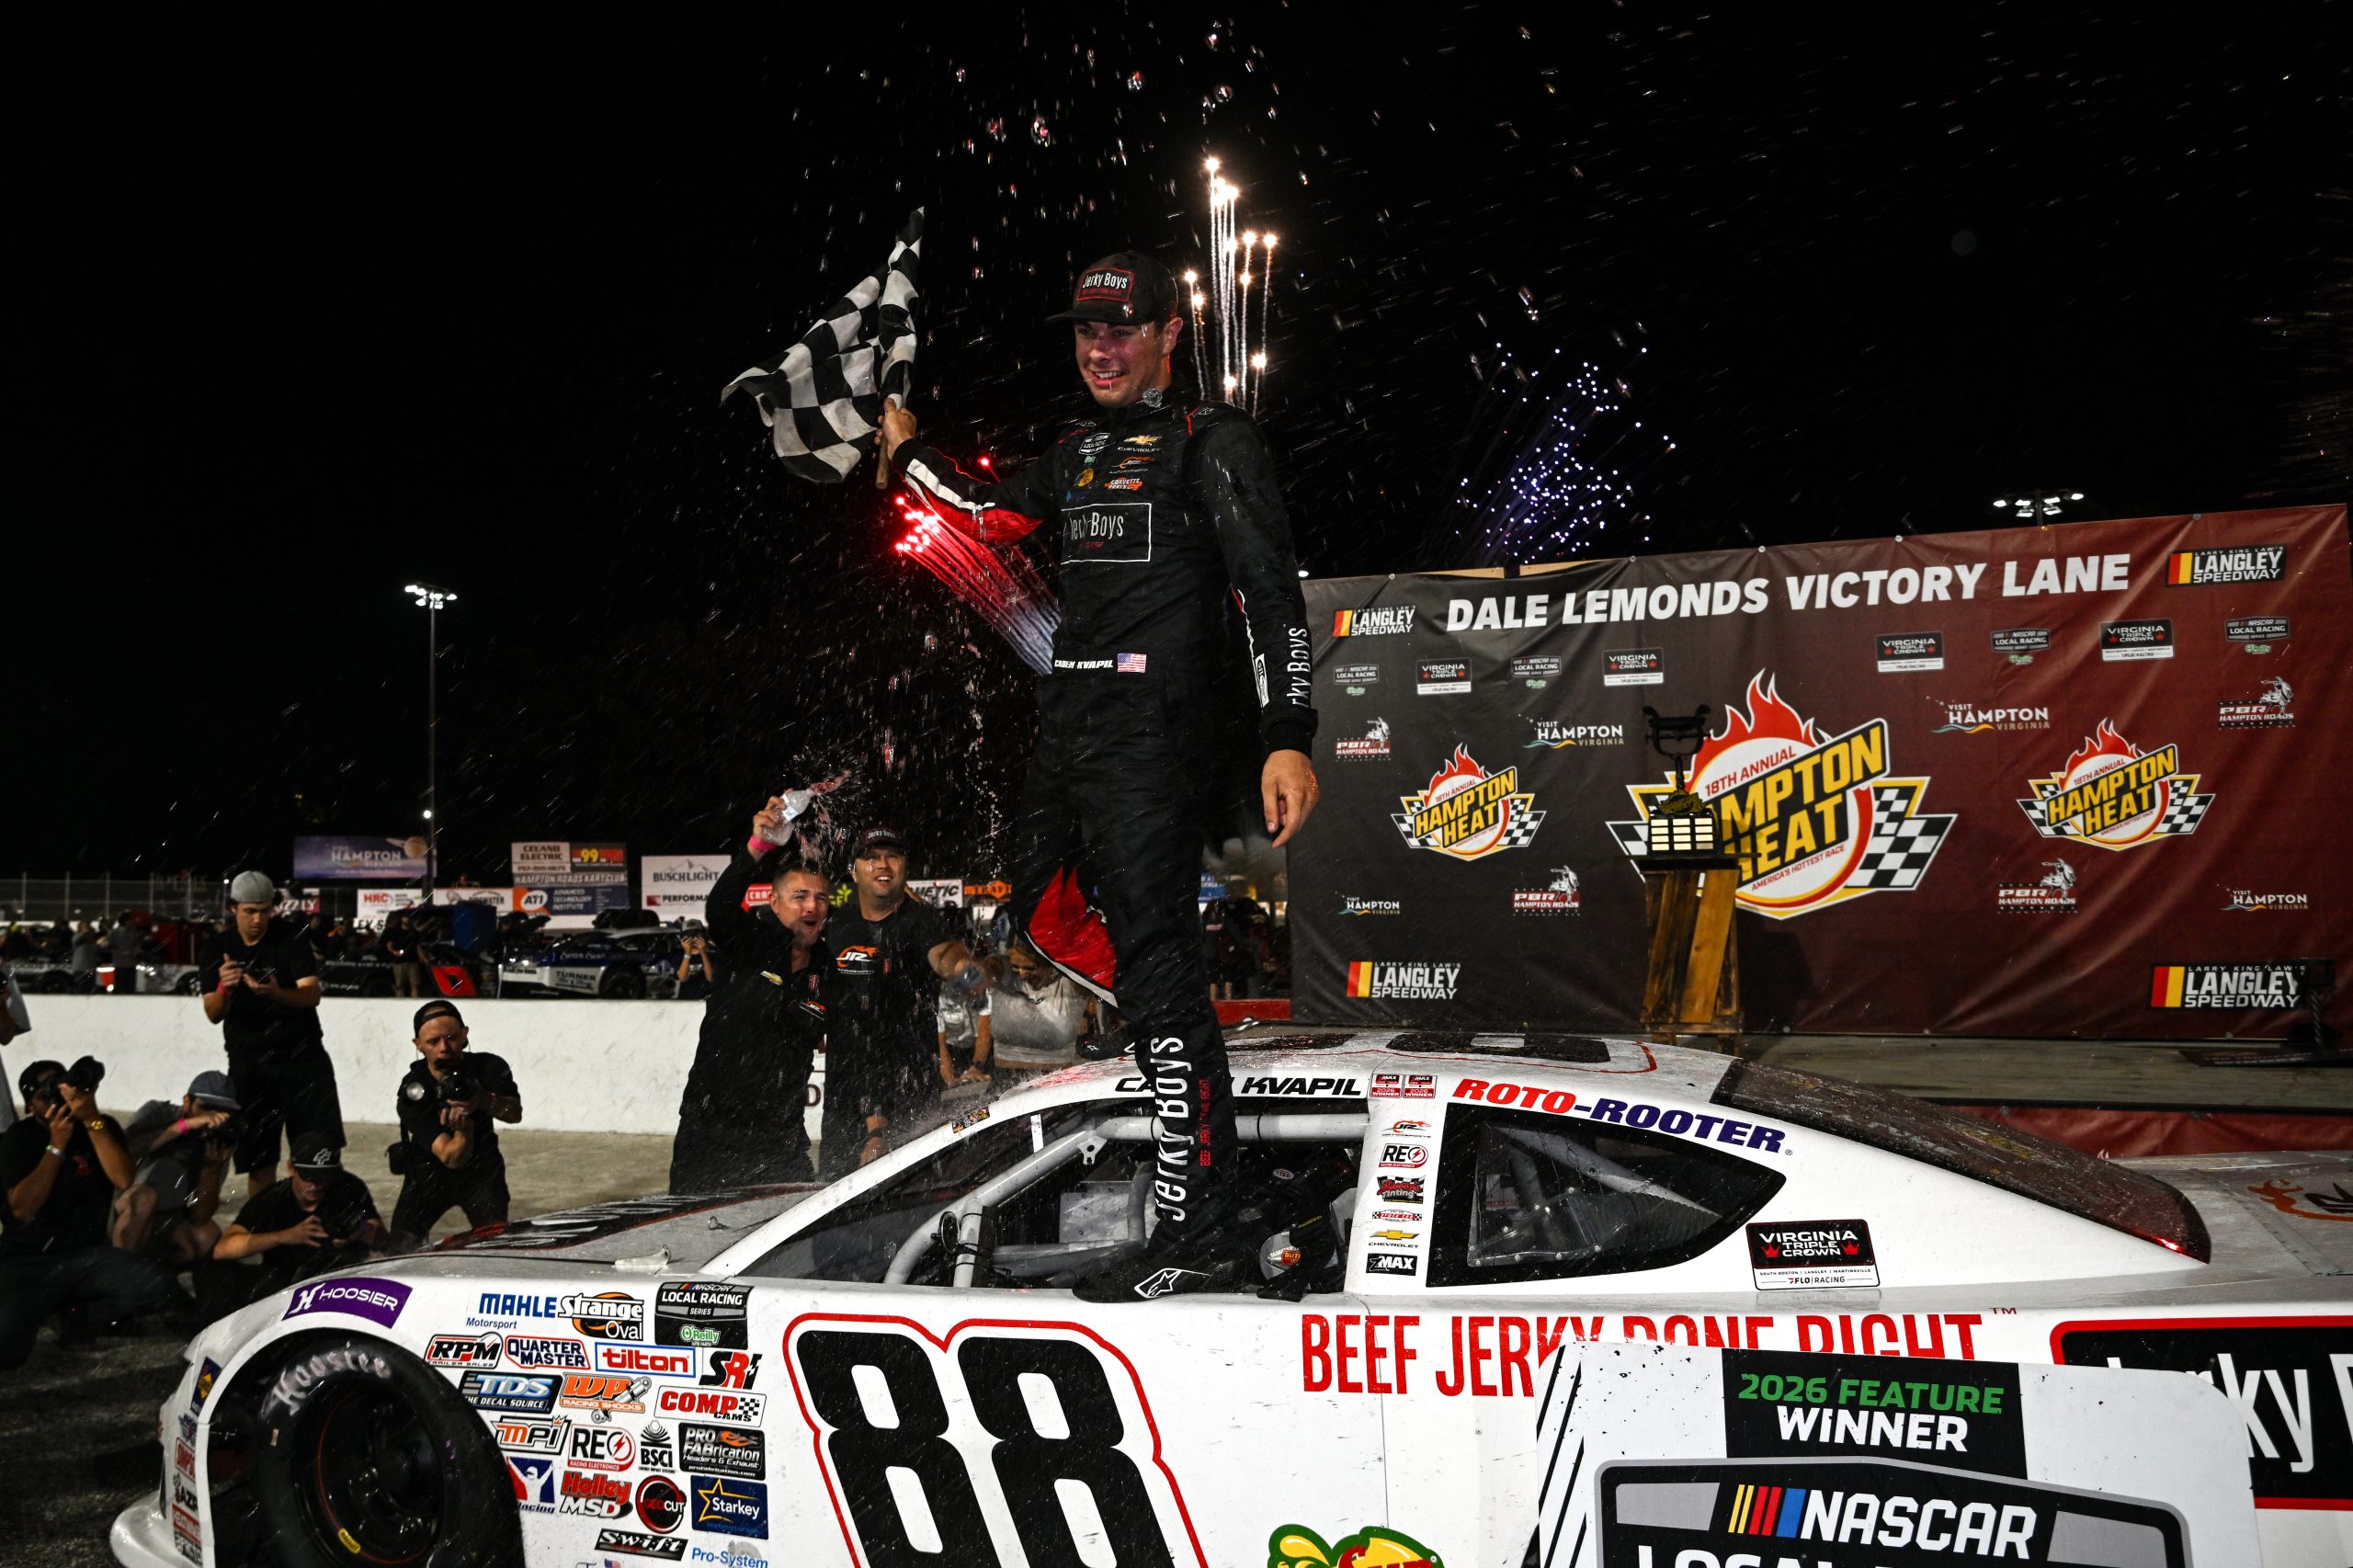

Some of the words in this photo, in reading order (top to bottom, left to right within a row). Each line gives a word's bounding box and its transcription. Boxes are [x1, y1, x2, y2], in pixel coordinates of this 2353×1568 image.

[1082, 273, 1103, 288] Jerky
[1104, 272, 1128, 289] Boys
[1090, 512, 1124, 540] Boys
[2194, 551, 2283, 574] LANGLEY
[2193, 568, 2280, 584] SPEEDWAY
[1447, 595, 1549, 631] DALE
[1563, 579, 1768, 625] LEMONDS
[1786, 562, 1987, 610] VICTORY
[2002, 553, 2131, 597] LANE
[1351, 609, 1416, 628] LANGLEY
[1351, 624, 1414, 636] SPEEDWAY
[2107, 625, 2165, 634] VIRGINIA
[1287, 628, 1312, 673] Boys
[1882, 638, 1937, 646] VIRGINIA
[1054, 660, 1075, 668] CADEN
[1076, 660, 1114, 669] KVAPIL
[1608, 653, 1657, 662] VIRGINIA
[1422, 664, 1465, 672] VIRGINIA
[1949, 708, 2049, 724] HAMPTON
[2220, 713, 2262, 722] HAMPTON
[1538, 724, 1623, 740] HAMPTON
[1996, 722, 2051, 731] VIRGINIA
[1578, 738, 1624, 746] VIRGINIA
[1705, 773, 1737, 797] 18TH
[1740, 745, 1797, 778] ANNUAL
[2094, 758, 2126, 777] ANNUAL
[1451, 779, 1477, 796] ANNUAL
[1706, 726, 1883, 842] MPTON
[2049, 747, 2175, 824] HAMPTON
[1415, 770, 1516, 837] HAMPTON
[2086, 784, 2153, 835] HEAT
[1444, 801, 1498, 846] HEAT
[1724, 793, 1843, 881] HEAT
[332, 851, 402, 862] HAMPTON
[581, 848, 599, 863] 99
[1751, 868, 1790, 891] AMERICA'S
[1791, 854, 1824, 874] HOTTEST
[1824, 844, 1845, 859] RACE
[515, 874, 555, 883] HAMPTON
[557, 874, 583, 883] ROADS
[364, 892, 390, 903] HRC
[1514, 892, 1554, 901] PBR
[1998, 897, 2043, 905] HAMPTON
[2044, 897, 2076, 905] ROADS
[1999, 889, 2048, 897] PBR
[2234, 894, 2308, 904] HAMPTON
[1347, 901, 1400, 910] HAMPTON
[1373, 967, 1460, 988] LANGLEY
[2186, 971, 2302, 994] LANGLEY
[1371, 986, 1458, 999] SPEEDWAY
[2184, 994, 2301, 1008] SPEEDWAY
[1150, 1037, 1192, 1119] Boys
[1241, 1076, 1362, 1096] KVAPIL
[1452, 1078, 1786, 1153] ROTO-ROOTER
[1199, 1123, 1211, 1145] JERKY
[1199, 1149, 1211, 1166] BEEF
[1154, 1130, 1195, 1222] Jerky
[1759, 1230, 1859, 1243] VIRGINIA
[1782, 1241, 1838, 1249] TRIPLE
[1782, 1248, 1841, 1256] CROWN
[691, 1283, 733, 1292] NASCAR
[319, 1288, 399, 1311] HOOSIER
[478, 1292, 558, 1318] MAHLE
[662, 1291, 698, 1303] LOCAL
[700, 1292, 743, 1305] RACING
[558, 1293, 644, 1323] Strange
[466, 1317, 517, 1329] Motorsport
[605, 1321, 642, 1340] Oval
[681, 1324, 721, 1344] O'Reilly
[432, 1341, 501, 1362] RPM
[507, 1338, 582, 1355] QUARTER
[1302, 1314, 1420, 1394] BEEF
[520, 1351, 586, 1367] MASTER
[602, 1347, 689, 1373] tilton
[699, 1350, 763, 1390] SRI
[476, 1374, 552, 1398] TDS
[563, 1375, 632, 1400] WP
[1738, 1373, 1828, 1403] 2026
[1839, 1378, 2005, 1415] FEATURE
[480, 1396, 507, 1406] DECAL
[510, 1398, 546, 1409] SOURCE
[563, 1399, 599, 1408] RACING
[602, 1402, 643, 1411] SHOCKS
[660, 1391, 739, 1415] COMP
[713, 1411, 752, 1422] CAMS
[686, 1427, 716, 1443] PRO
[1777, 1405, 1969, 1453] WINNER
[641, 1448, 673, 1468] BSCI
[683, 1441, 760, 1462] FABrication
[796, 1330, 1177, 1568] 88
[570, 1460, 588, 1469] RACING
[588, 1461, 620, 1471] ELECTRONICS
[682, 1453, 717, 1464] Headers
[727, 1458, 760, 1469] Exhaust
[688, 1465, 756, 1476] profabrication.com
[561, 1471, 632, 1506] Holley
[560, 1495, 622, 1517] MSD
[712, 1496, 760, 1520] Starkey
[1801, 1489, 2037, 1560] NASCAR
[691, 1547, 768, 1568] Pro-System
